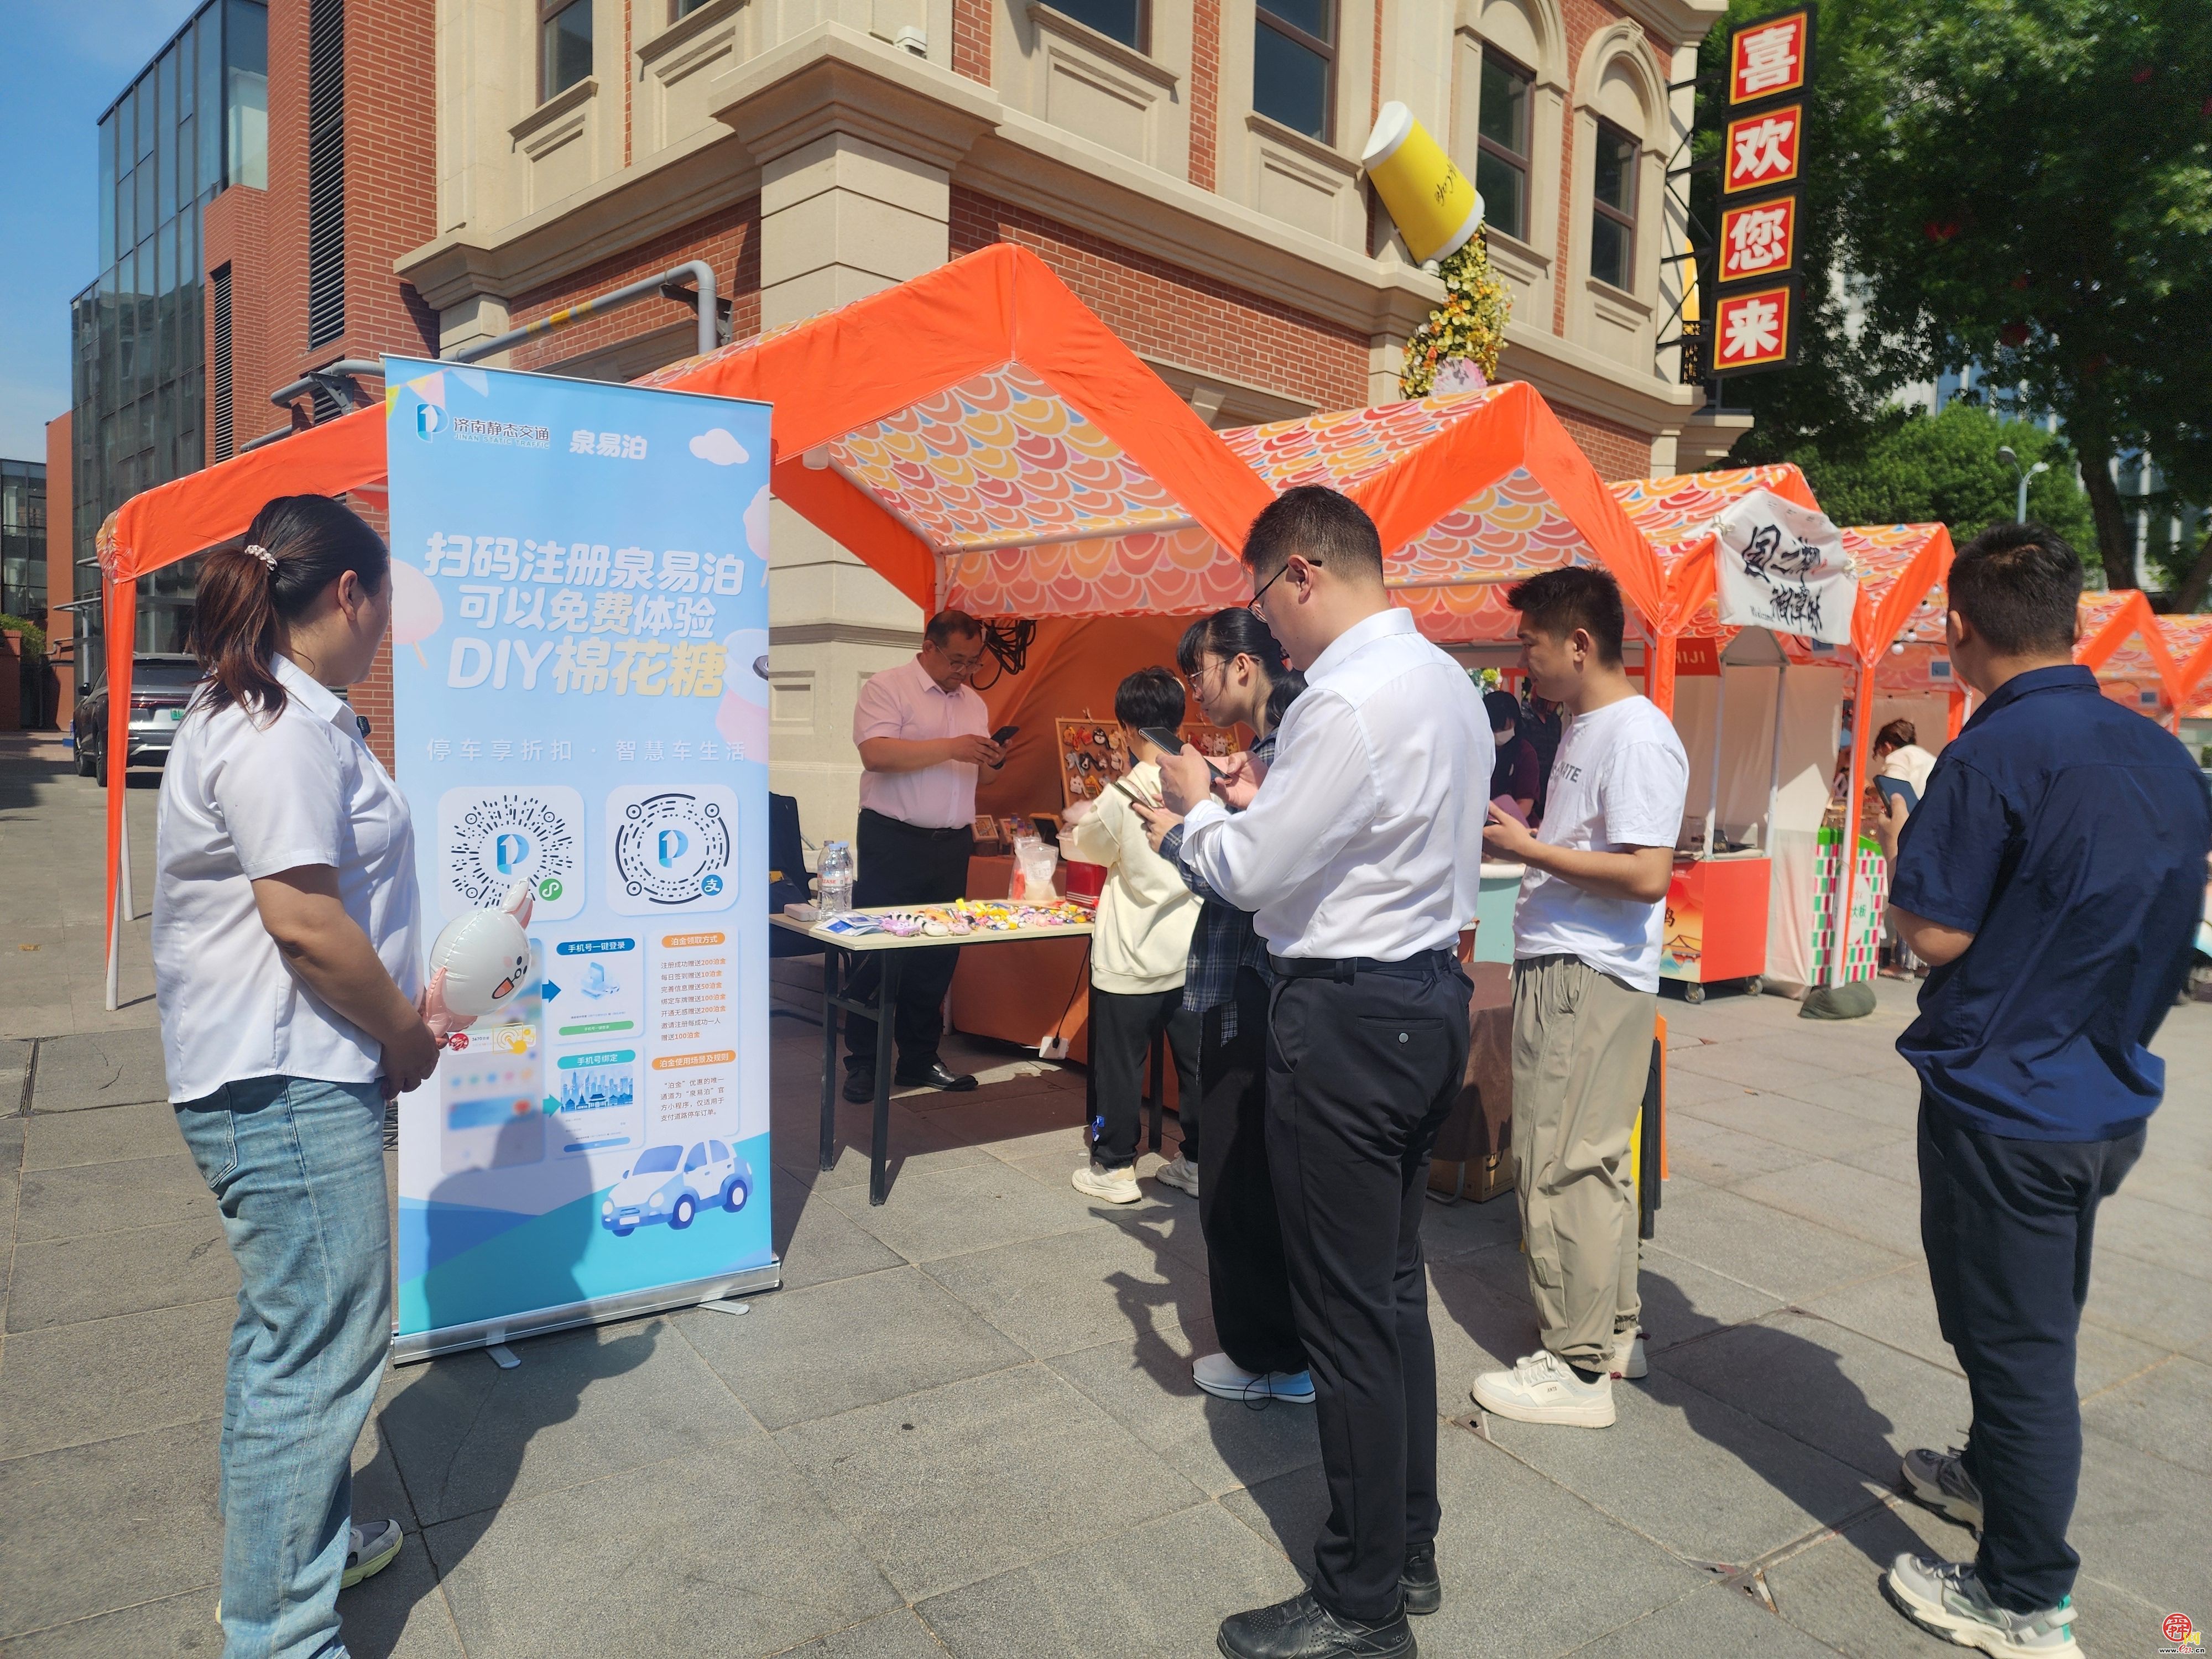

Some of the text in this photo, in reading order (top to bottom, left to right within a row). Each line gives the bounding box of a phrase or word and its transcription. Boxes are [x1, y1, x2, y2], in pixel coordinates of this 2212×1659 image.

[1723, 23, 1796, 358] 喜欢您来
[454, 418, 549, 441] 济南静态交通
[483, 436, 511, 445] STATIC
[516, 440, 549, 448] TRAFFIC
[569, 429, 647, 460] 泉易泊
[423, 531, 745, 596] 扫码注册泉易泊
[458, 585, 717, 639] 可以免费体验
[447, 635, 728, 698] DIY棉花糖
[426, 738, 745, 762] 停车享折扣 智慧车生活
[671, 935, 718, 946] 泊金领取方式
[568, 941, 625, 953] 手机号一键登录
[661, 958, 726, 969] 注册成功赠送200泊金
[661, 971, 722, 981] 每日签到赠送10泊金
[661, 982, 722, 993] 完善信息赠送50泊金
[661, 994, 726, 1005] 绑定车牌赠送100泊金
[661, 1005, 726, 1017] 开通无感赠送200泊金
[661, 1018, 721, 1029] 邀请注册每成功一人
[661, 1031, 700, 1041] 赠送100泊金
[577, 1054, 618, 1066] 手机号绑定
[660, 1053, 728, 1068] 泊金使用场景及规则
